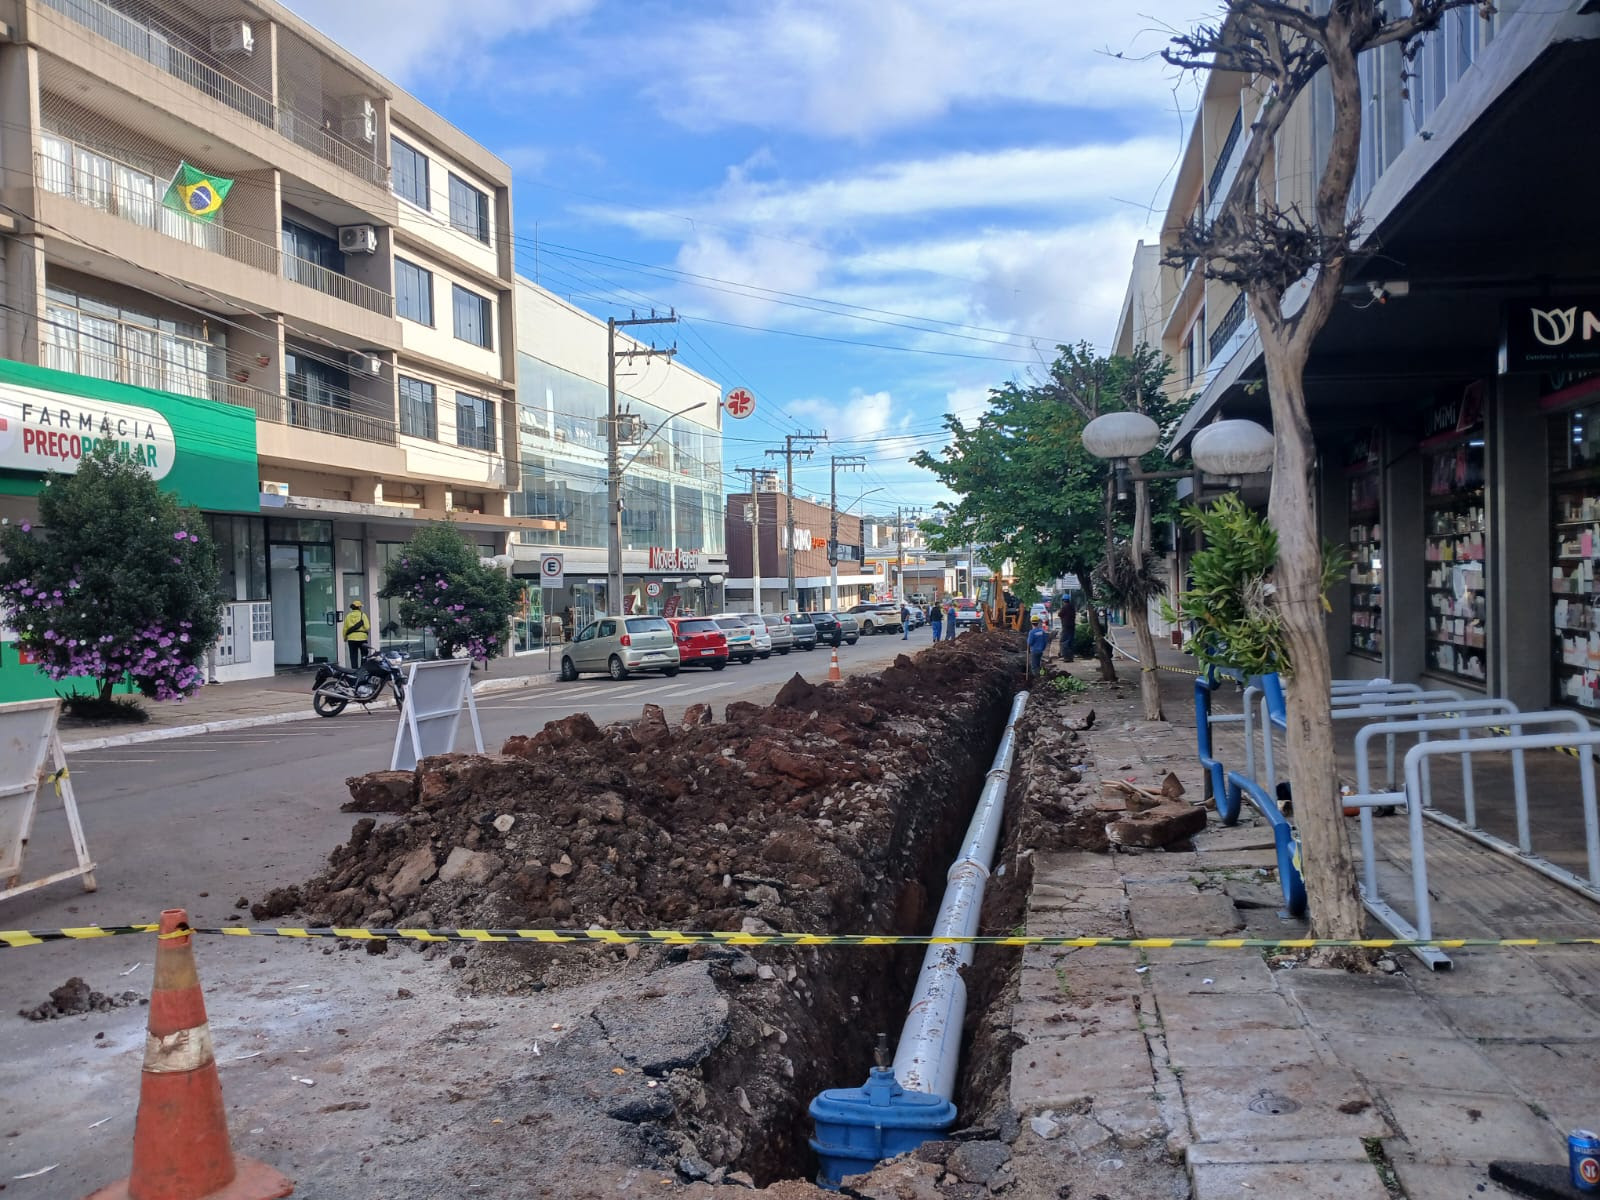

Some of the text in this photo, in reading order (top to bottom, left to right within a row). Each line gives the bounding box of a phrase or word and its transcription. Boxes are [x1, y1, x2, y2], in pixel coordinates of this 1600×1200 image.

[22, 403, 156, 440] FARMÁCIA
[548, 562, 556, 571] E
[648, 584, 658, 592] 40
